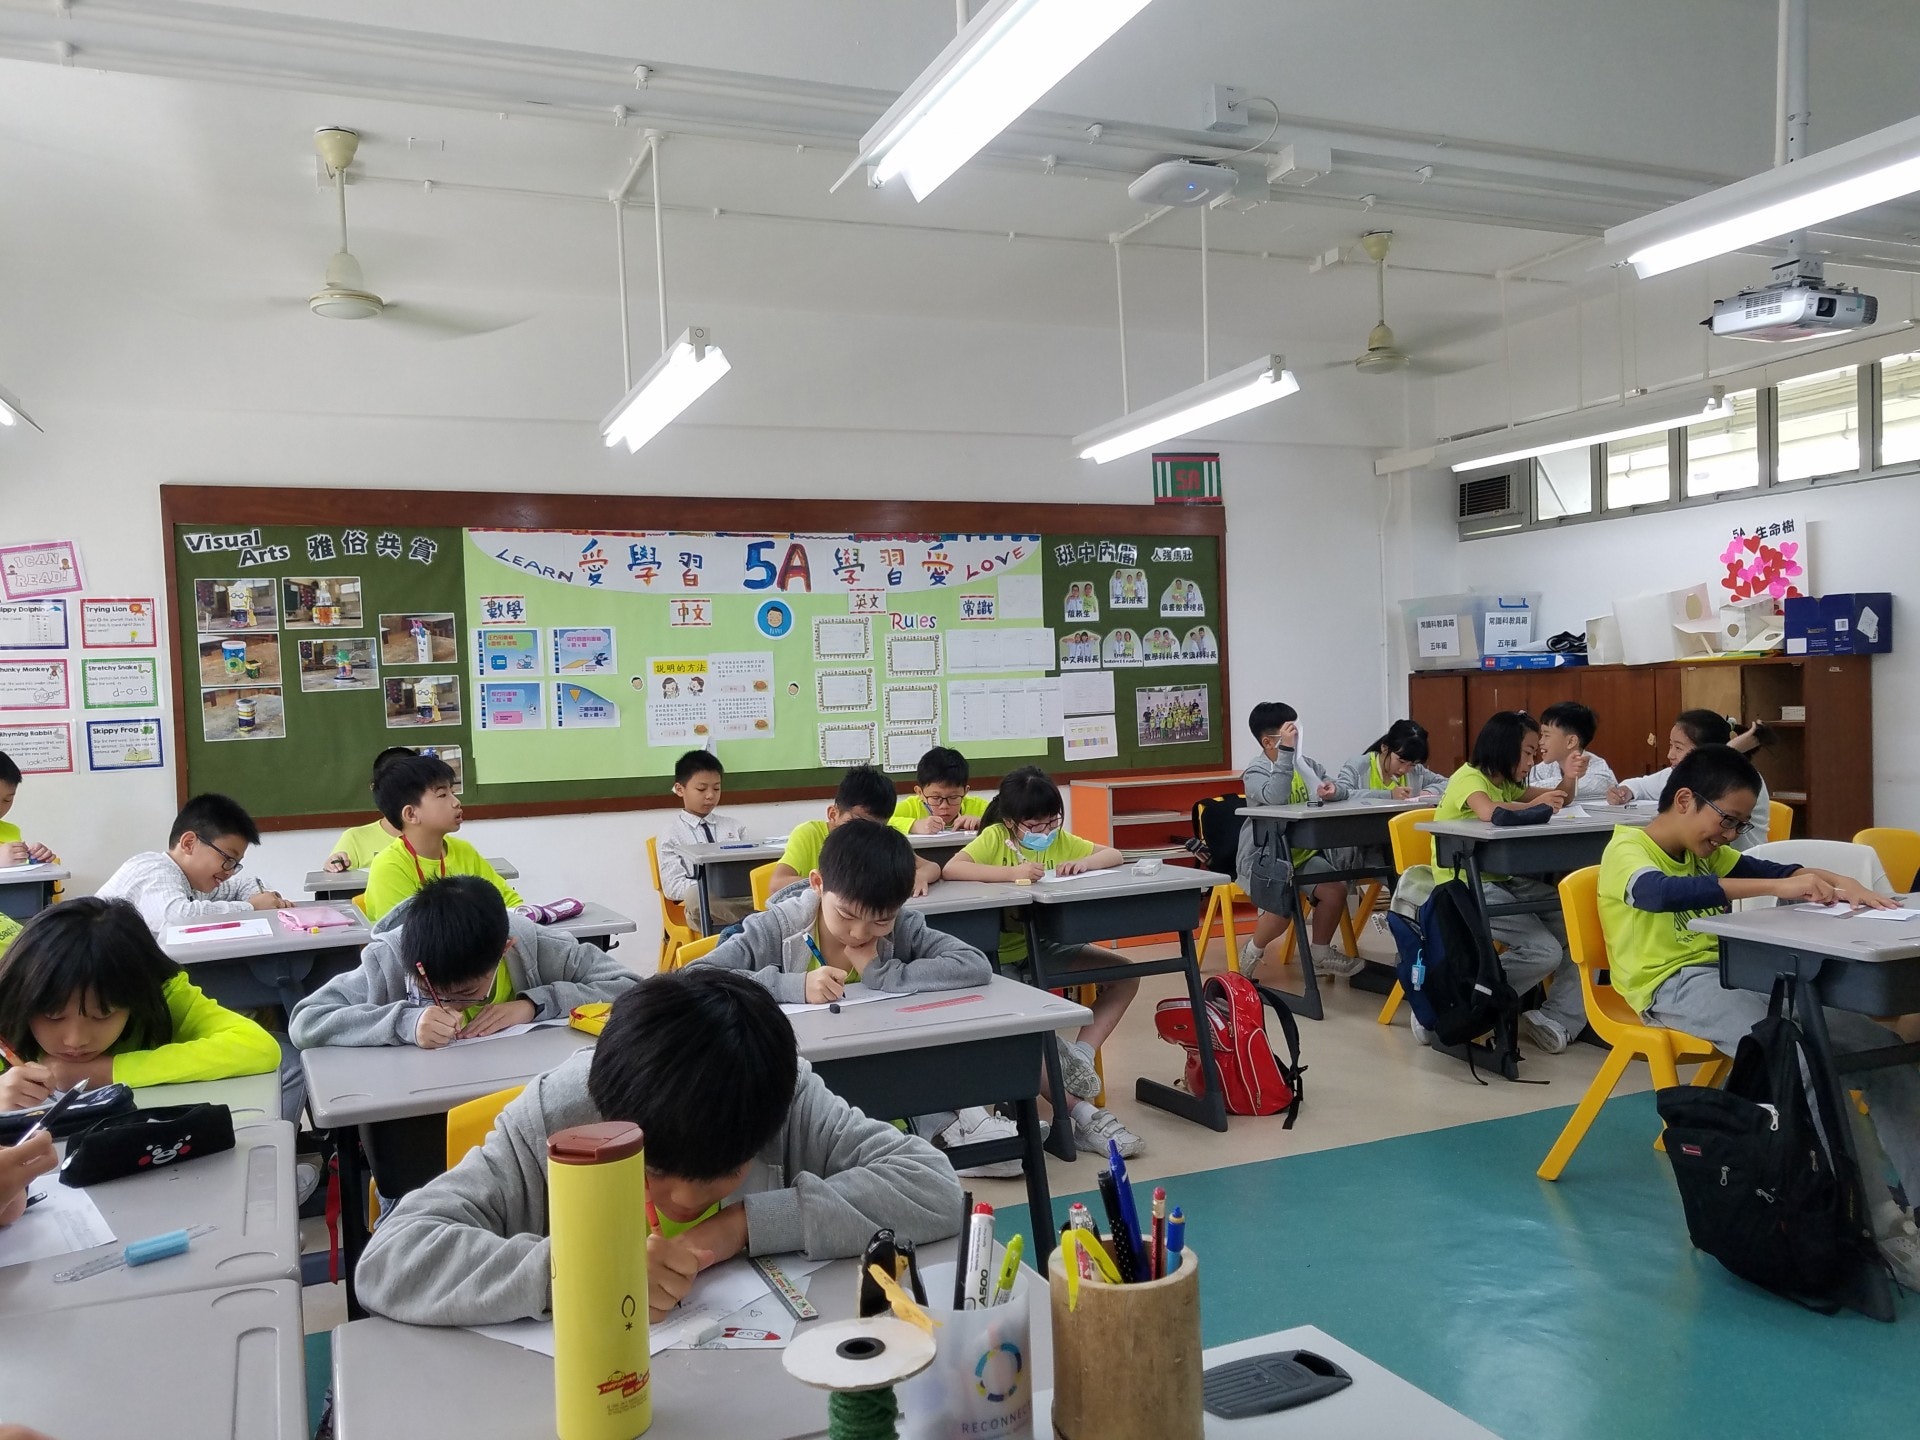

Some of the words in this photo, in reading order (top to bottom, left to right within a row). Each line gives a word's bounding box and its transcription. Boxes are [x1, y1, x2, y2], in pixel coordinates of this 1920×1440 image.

[1755, 518, 1795, 540] 生命樹
[185, 529, 261, 552] Visual
[307, 529, 437, 565] 雅俗共賞
[24, 552, 59, 567] CAN
[240, 545, 290, 567] Arts
[495, 548, 574, 583] LEARN
[743, 540, 812, 593] 5A
[966, 546, 1026, 582] LOVE
[15, 570, 68, 588] READ!
[18, 606, 45, 614] Dolphin
[85, 605, 111, 613] Trying
[483, 598, 524, 620] 數學
[854, 593, 880, 610] 英文
[962, 599, 993, 617] 常識
[678, 602, 705, 623] 中文
[889, 612, 938, 631] Rules
[120, 726, 139, 734] Frog
[979, 1268, 989, 1308] A500
